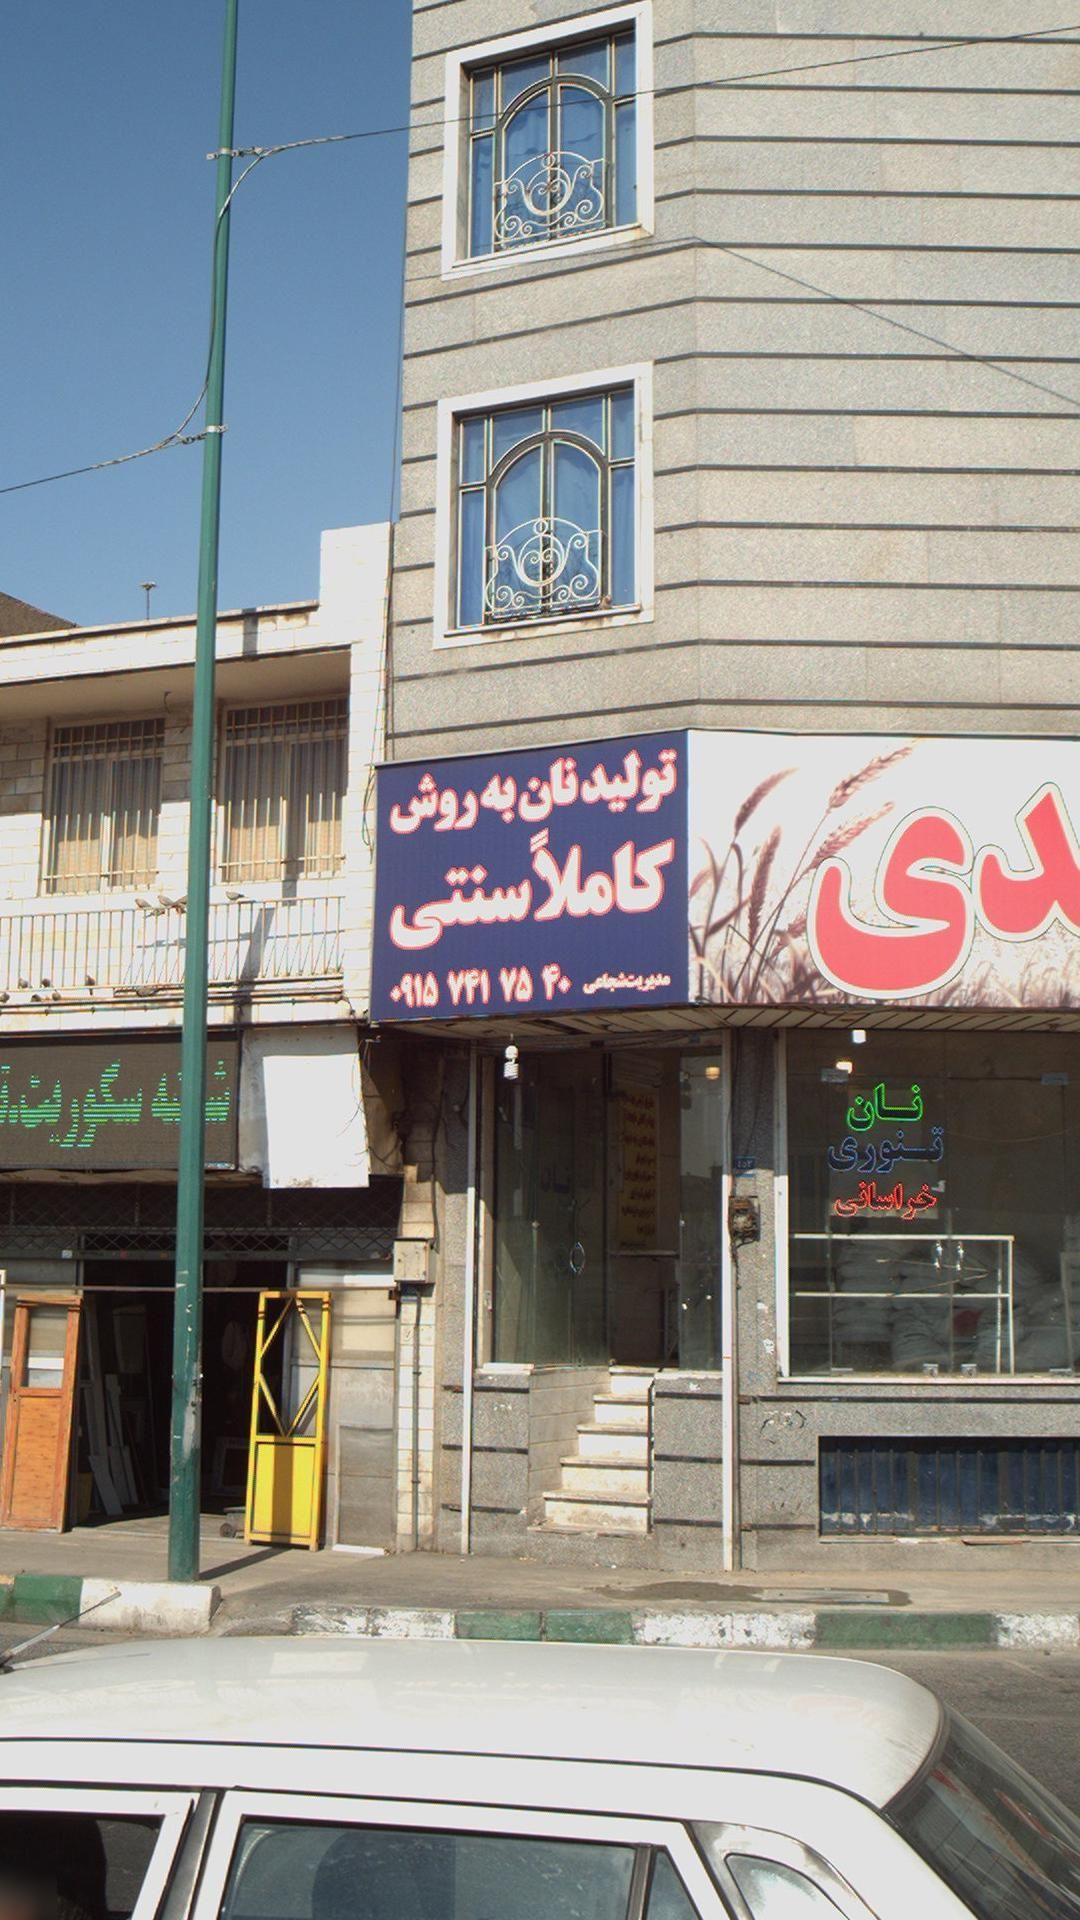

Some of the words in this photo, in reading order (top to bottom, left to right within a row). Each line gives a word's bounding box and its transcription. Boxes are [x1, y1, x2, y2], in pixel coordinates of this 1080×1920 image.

[390, 773, 479, 834] روش
[480, 774, 517, 823] به
[518, 757, 580, 822] نان
[580, 749, 678, 812] تولید
[390, 863, 533, 949] سنتی
[390, 971, 440, 1008] ۰۹۱۵
[499, 965, 533, 1002] ۷۵
[541, 962, 572, 1000] ۴۰
[847, 1083, 924, 1132] نان
[827, 1126, 945, 1174] تنوری
[833, 1180, 938, 1221] خراسانی
